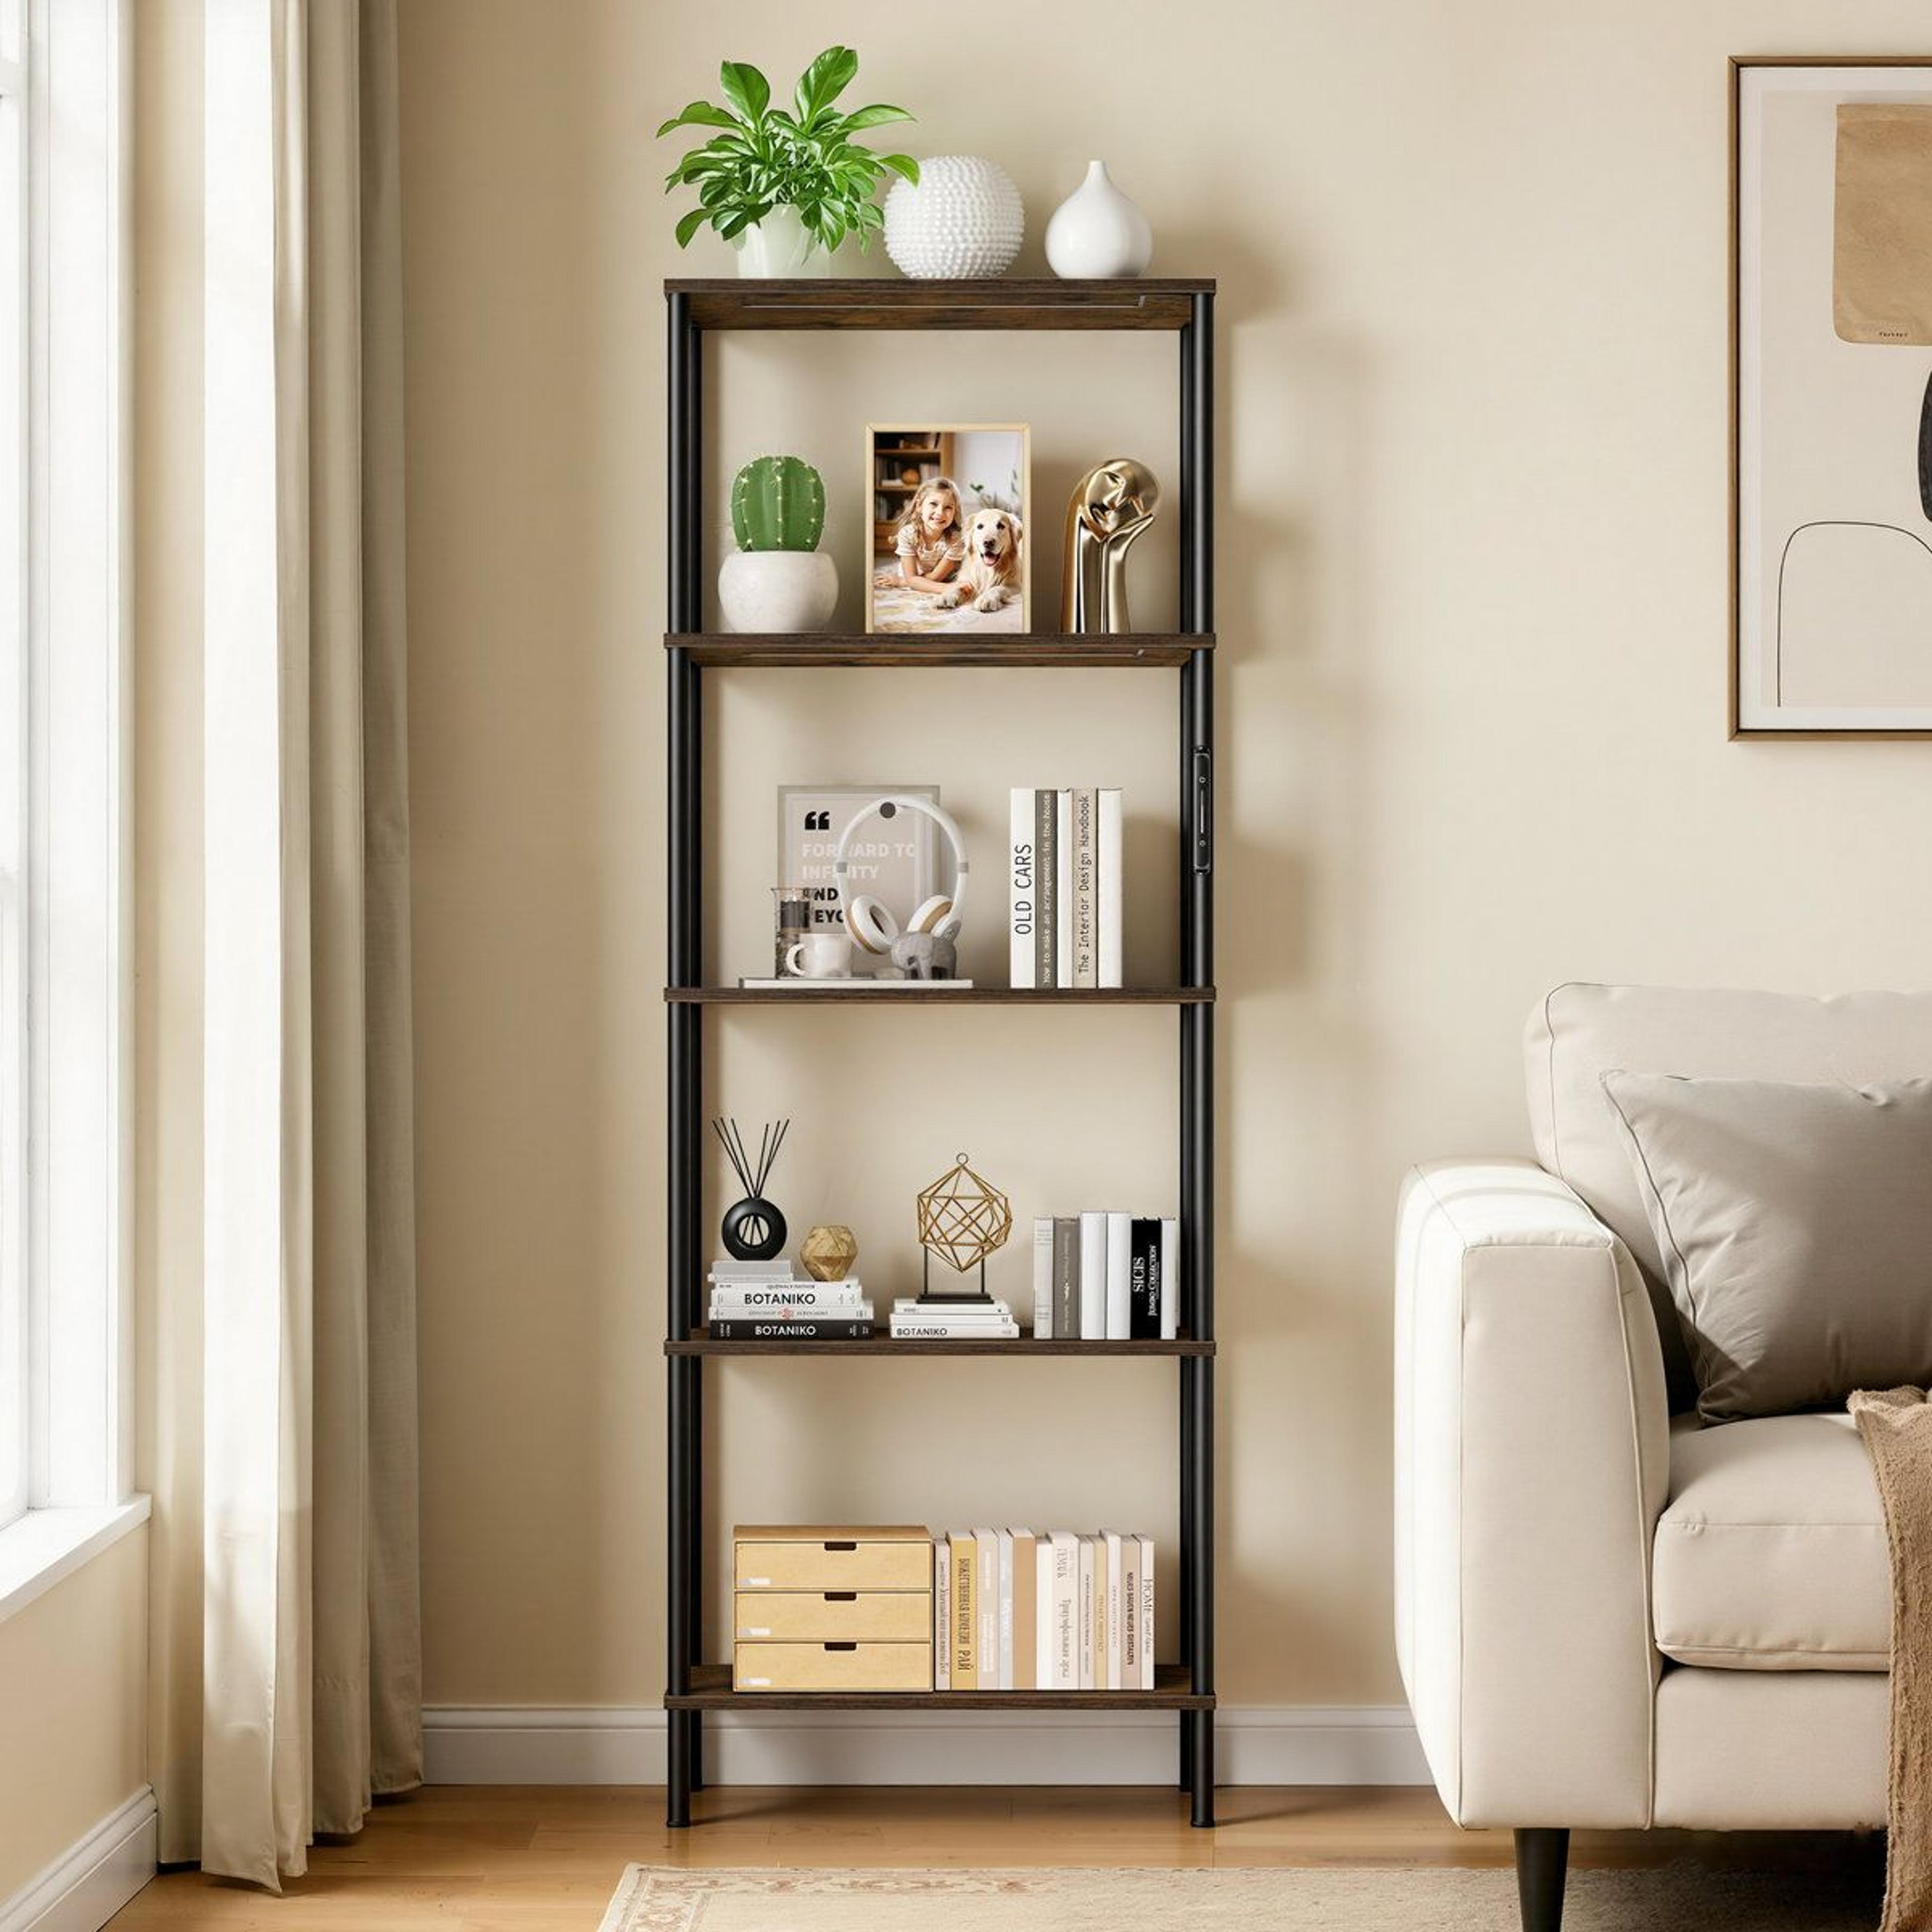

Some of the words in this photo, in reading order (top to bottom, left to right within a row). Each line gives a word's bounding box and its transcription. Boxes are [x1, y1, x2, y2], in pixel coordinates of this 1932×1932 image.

[1079, 795, 1089, 847] Handbook
[1042, 841, 1050, 853] in
[1014, 844, 1032, 889] CARS
[1079, 853, 1091, 891] Design
[1014, 901, 1032, 935] OLD
[1044, 914, 1050, 925] an
[1079, 898, 1089, 948] Interior
[1043, 953, 1050, 963] to
[1079, 954, 1089, 973] The
[1133, 1257, 1145, 1292] SICIS
[745, 1294, 816, 1305] BOTANIKO
[755, 1326, 816, 1336] BOTANIKO
[897, 1328, 947, 1336] BOTANIKO
[1143, 1579, 1153, 1614] HOME
